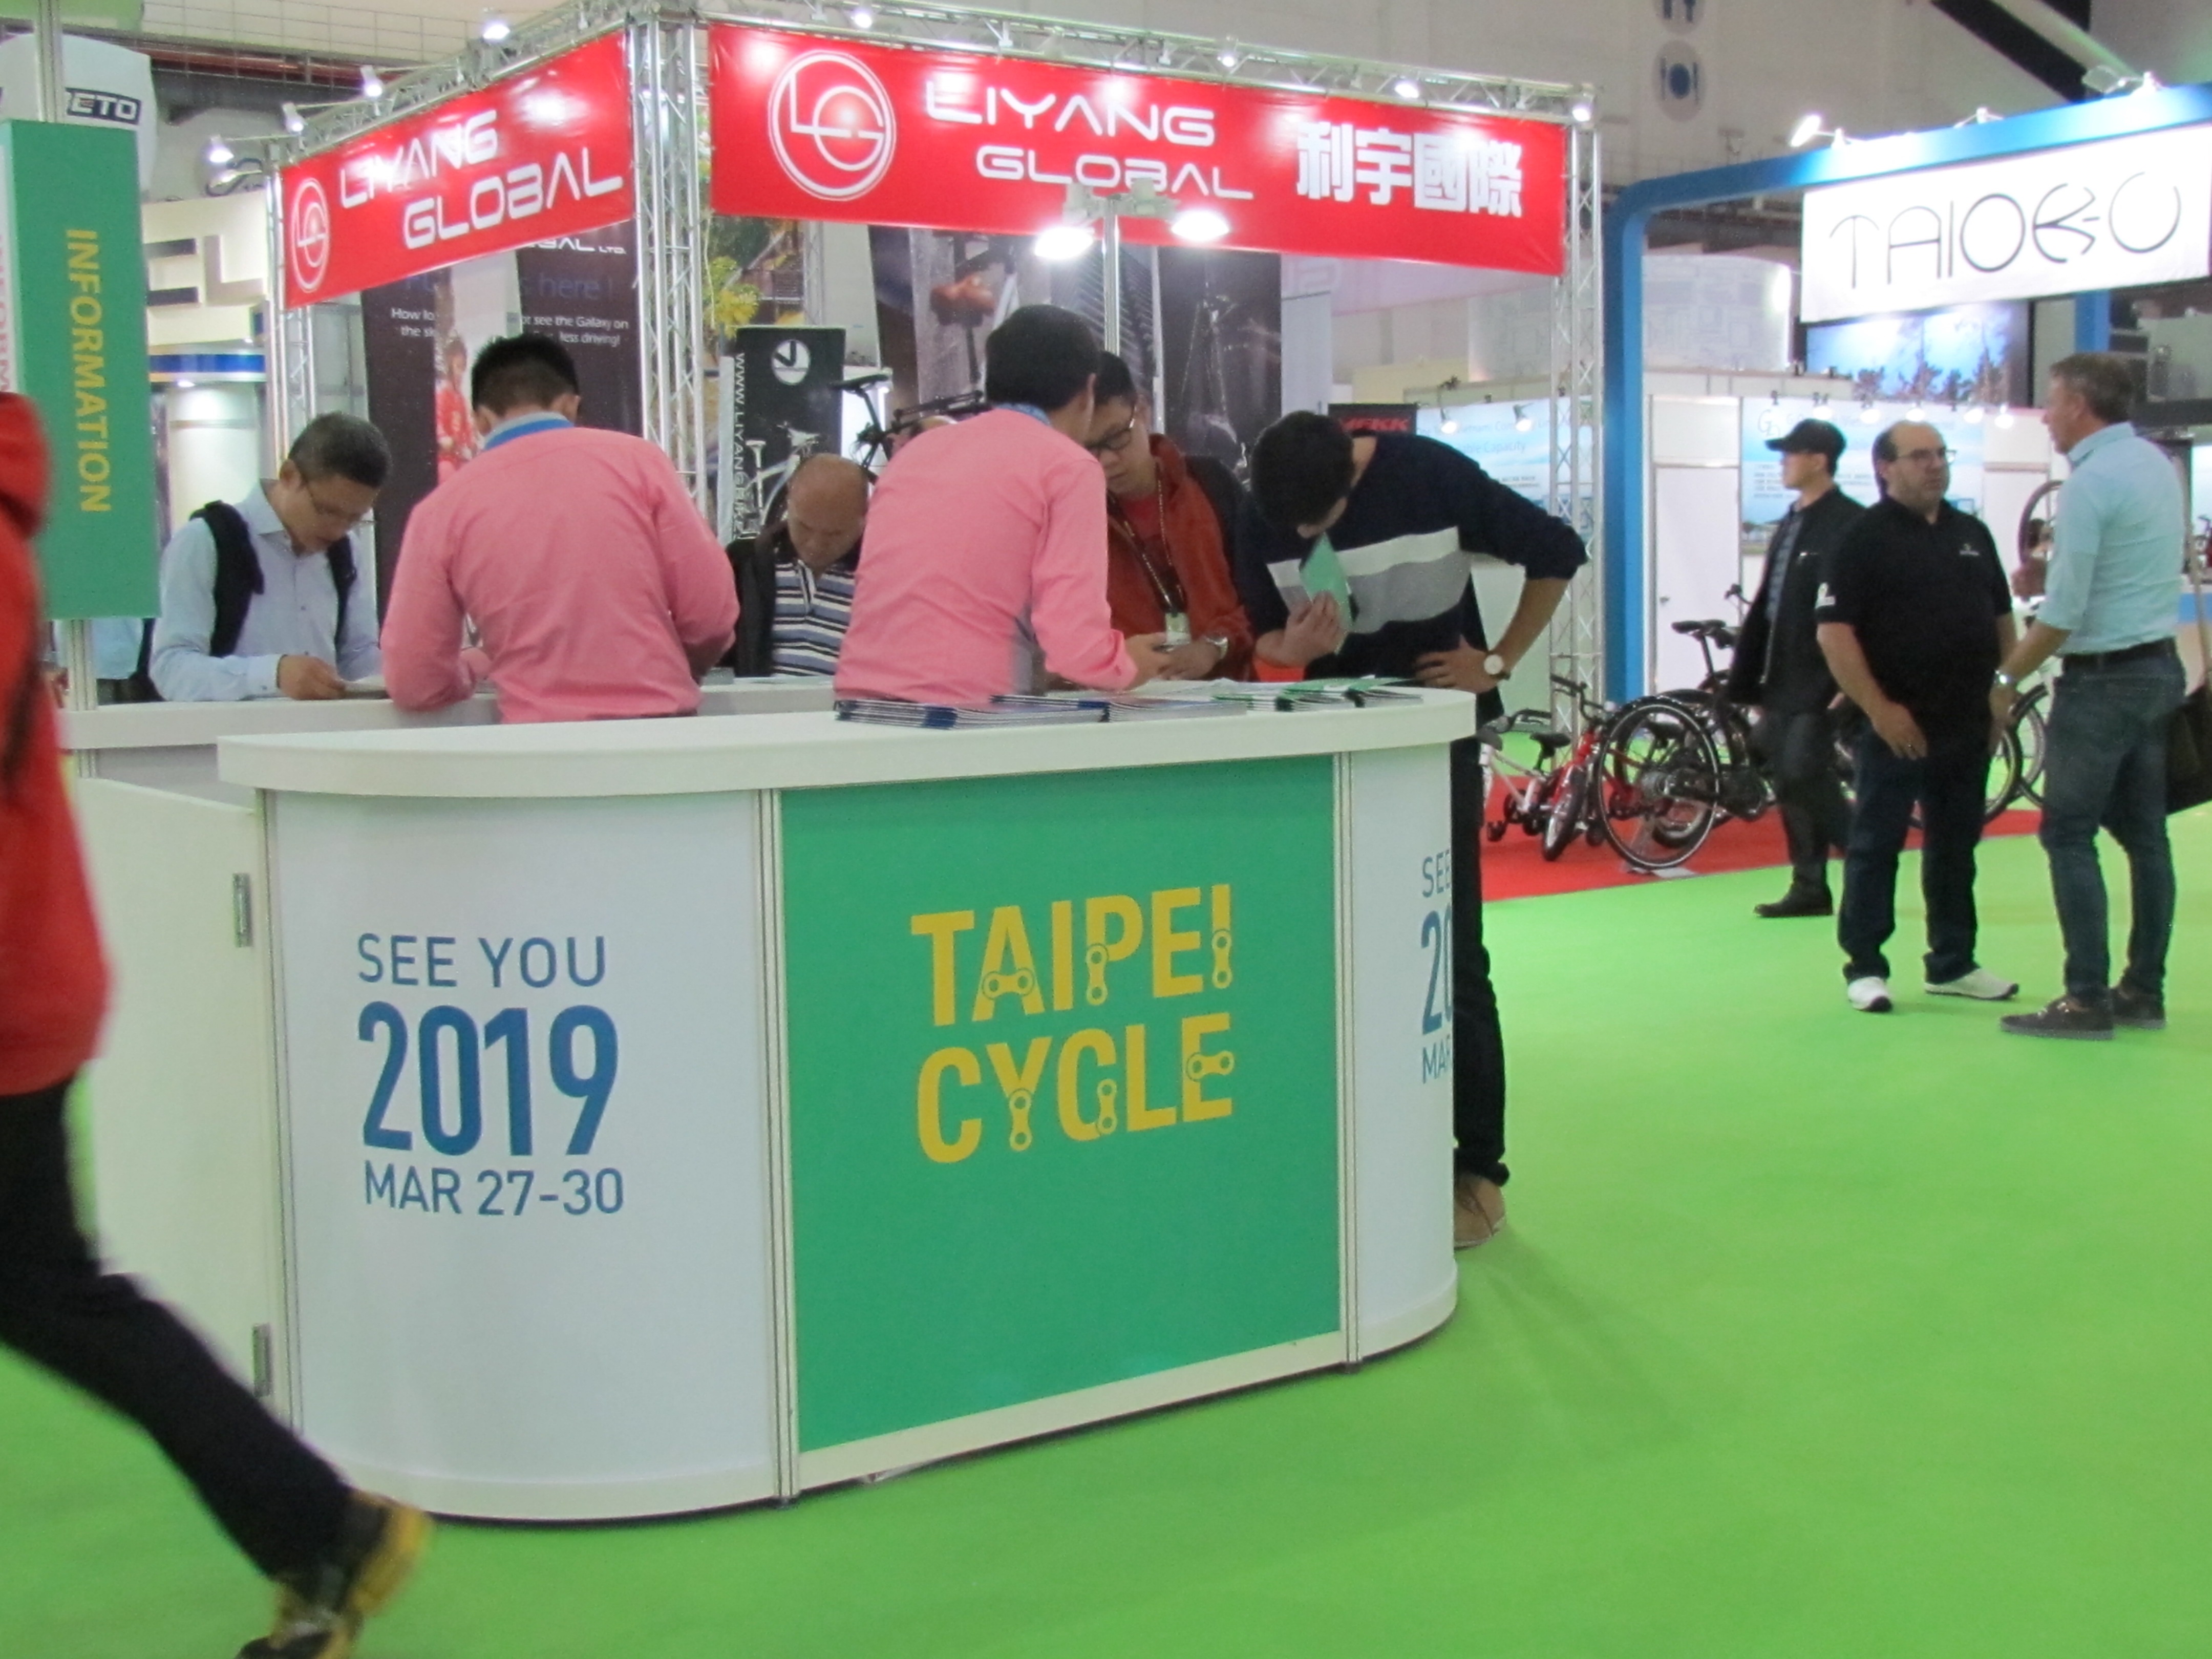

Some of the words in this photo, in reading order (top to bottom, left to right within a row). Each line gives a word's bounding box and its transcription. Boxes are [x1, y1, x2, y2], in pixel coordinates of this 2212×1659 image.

[339, 110, 497, 208] LIYANG
[926, 79, 1215, 147] LIYANG
[403, 147, 623, 249] GLOBAL
[976, 145, 1254, 200] GLOBAL
[1296, 121, 1522, 218] 利宇國際
[65, 228, 112, 514] INFORMATION
[534, 316, 552, 326] see
[556, 316, 573, 327] the
[576, 316, 611, 331] Galaxy
[614, 320, 629, 329] on
[358, 932, 458, 987] SEE
[478, 936, 606, 988] YOU
[911, 884, 1233, 1027] TAIPEI
[358, 1001, 619, 1156] 2019
[917, 1012, 1235, 1163] CYCLE
[365, 1159, 462, 1215] MAR
[476, 1167, 624, 1216] 27-30
